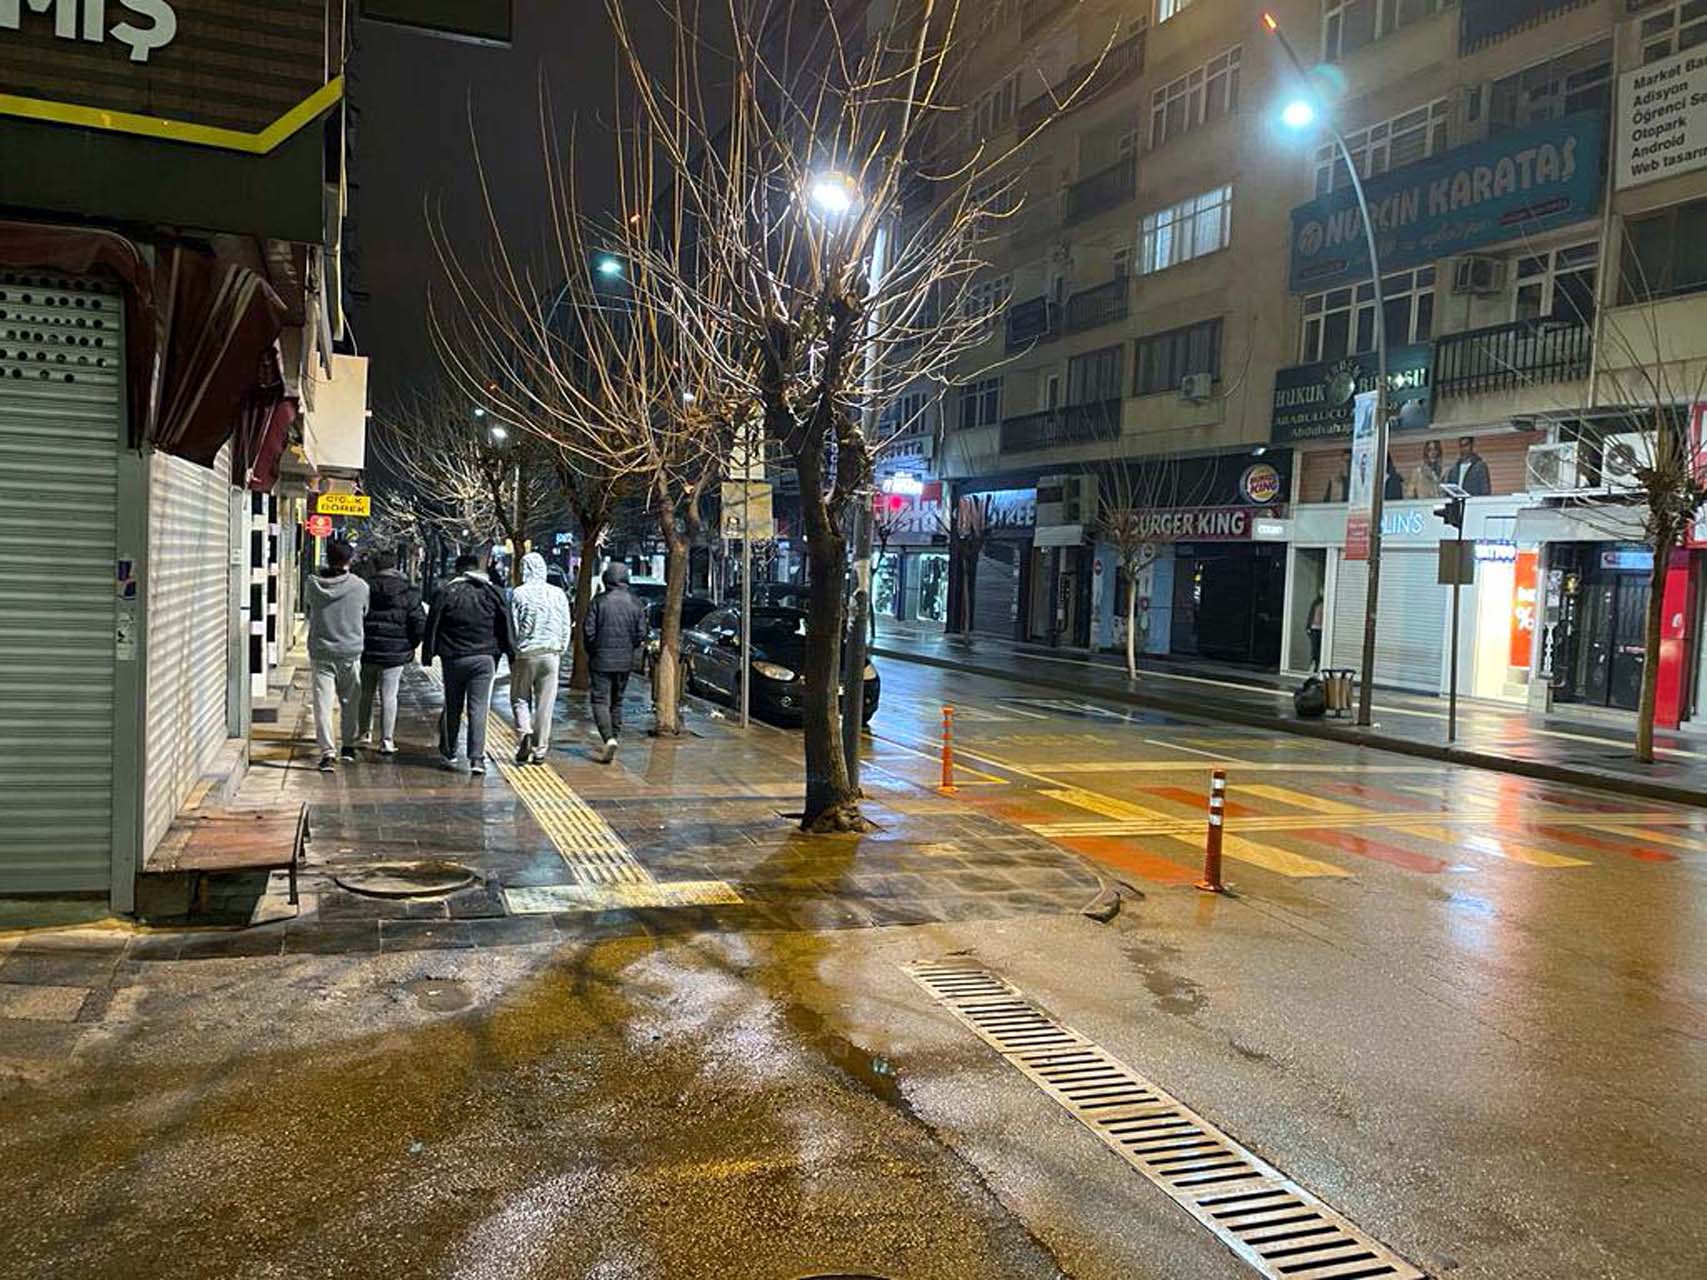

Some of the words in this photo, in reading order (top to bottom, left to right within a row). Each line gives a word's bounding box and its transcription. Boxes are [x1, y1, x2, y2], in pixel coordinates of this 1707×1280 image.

[1633, 64, 1682, 91] Market
[1685, 57, 1707, 73] Ba
[1632, 81, 1689, 108] Adisyon
[1632, 98, 1687, 125] Öğrenci
[1631, 116, 1687, 143] Otopark
[1631, 132, 1686, 161] Android
[1631, 159, 1660, 177] Web
[1663, 146, 1707, 168] tasarı
[1429, 136, 1577, 217] KARATAŞ
[1275, 384, 1327, 408] HUKUK
[1197, 510, 1245, 535] KING
[1380, 510, 1425, 534] LIN'S
